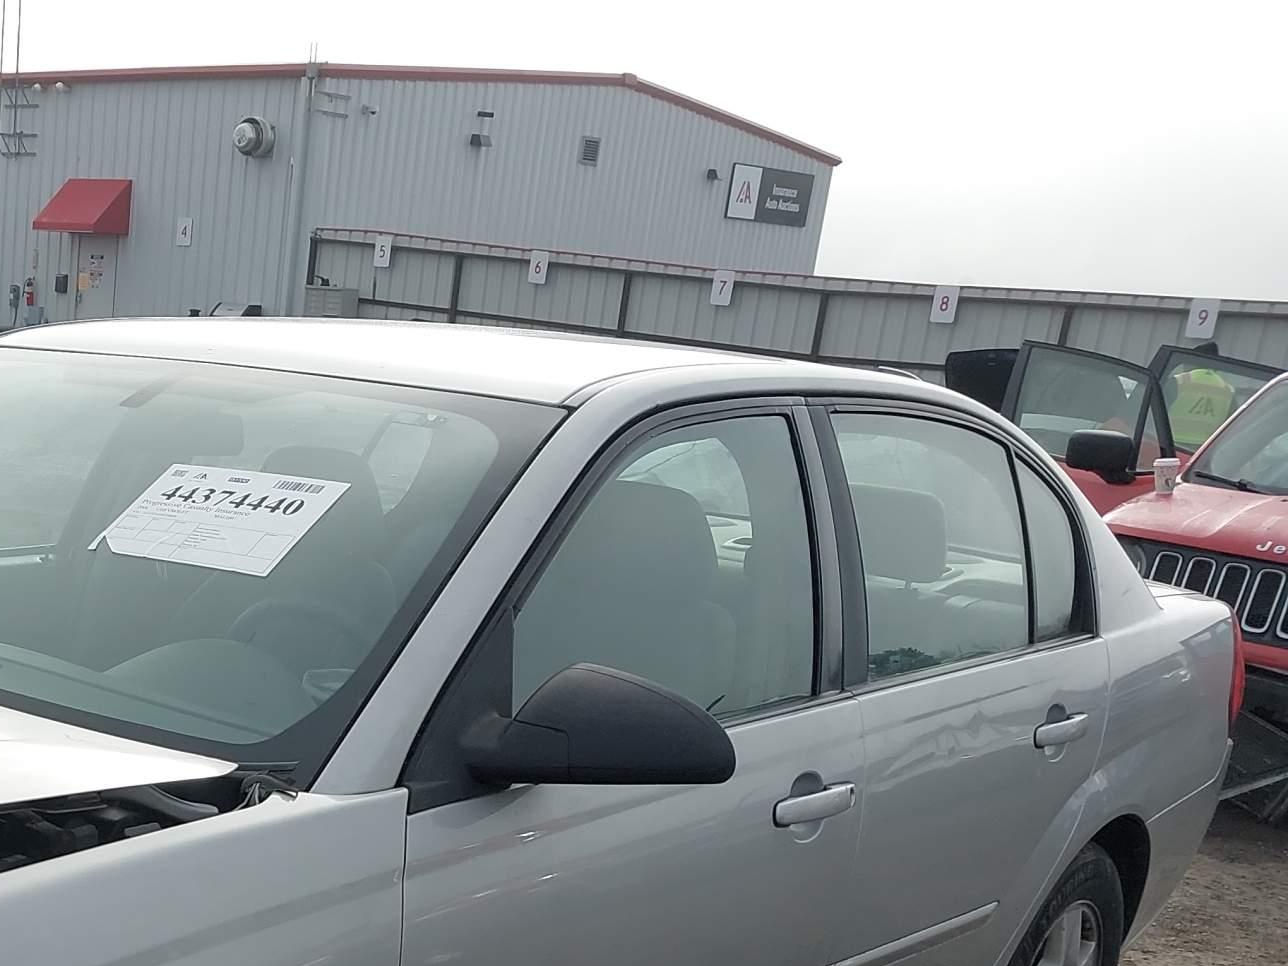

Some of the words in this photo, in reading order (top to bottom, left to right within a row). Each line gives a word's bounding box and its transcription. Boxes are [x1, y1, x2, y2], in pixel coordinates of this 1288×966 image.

[181, 225, 187, 238] 4
[379, 245, 386, 258] 5
[534, 261, 541, 274] 6
[719, 280, 728, 296] 7
[940, 295, 950, 311] 8
[1198, 309, 1209, 326] 9
[161, 484, 305, 516] 44374440
